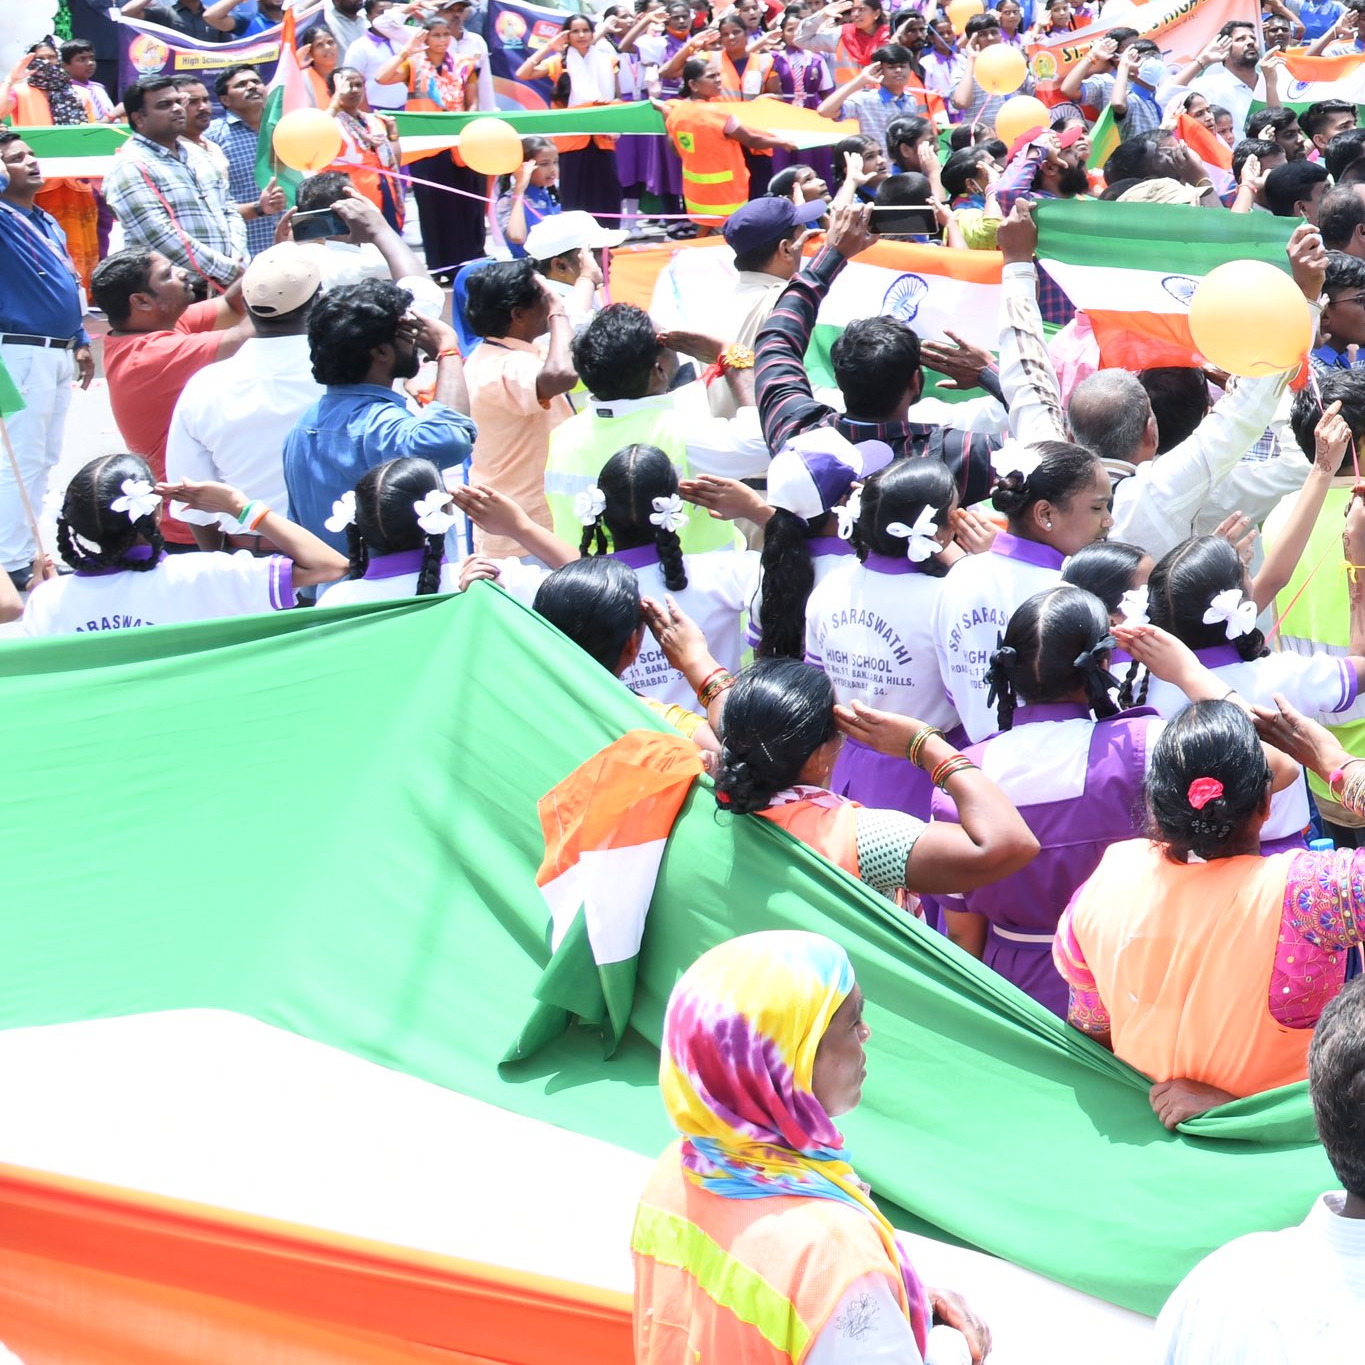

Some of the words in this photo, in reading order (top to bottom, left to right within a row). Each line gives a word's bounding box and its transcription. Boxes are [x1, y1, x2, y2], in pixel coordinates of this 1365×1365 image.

[76, 614, 154, 633] RASWA
[962, 606, 1009, 630] SARAS
[831, 608, 913, 666] SARASWATHI
[639, 649, 666, 664] SCH
[826, 648, 849, 665] HIGH
[851, 653, 893, 674] SCHOOL
[626, 675, 669, 691] DERABAD
[886, 676, 916, 688] HILLS.
